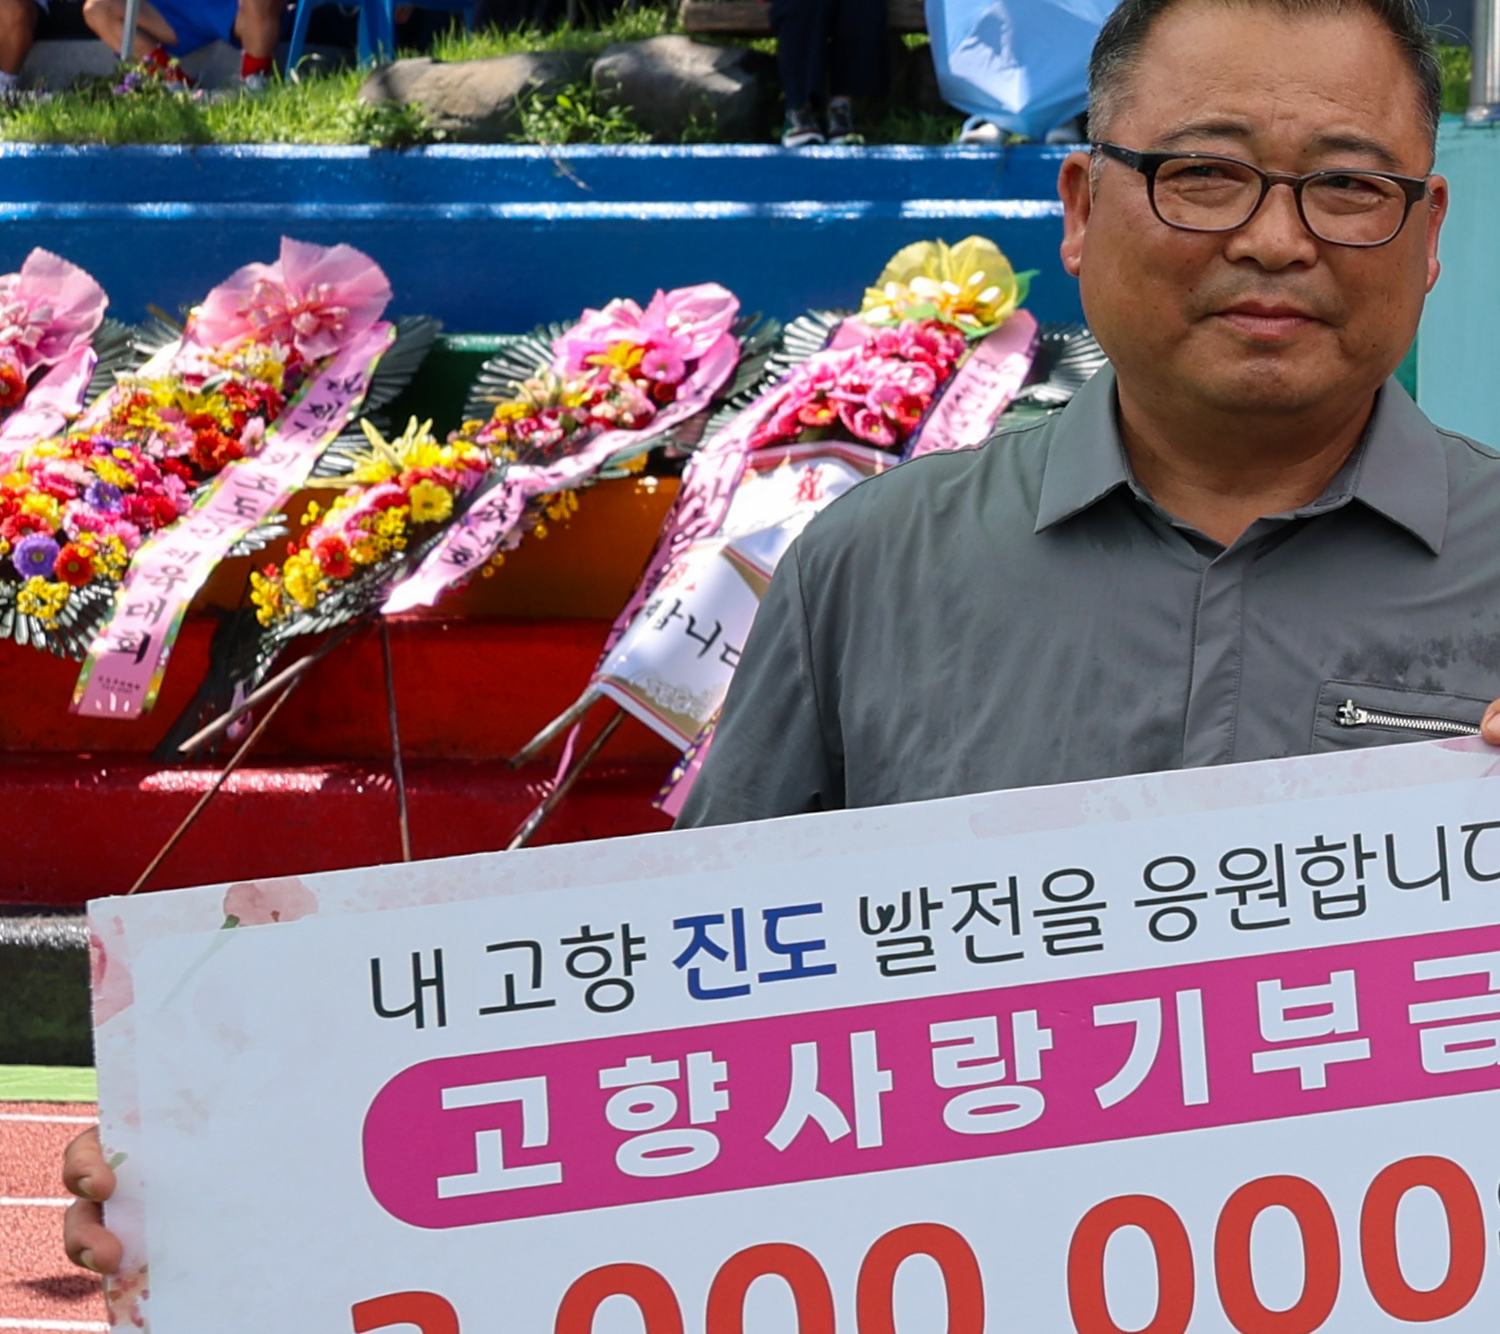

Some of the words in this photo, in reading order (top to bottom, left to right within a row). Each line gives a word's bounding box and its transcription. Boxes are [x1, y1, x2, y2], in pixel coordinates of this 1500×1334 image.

[371, 949, 446, 1029] 내
[479, 923, 646, 1015] 고향
[674, 904, 836, 999] 진도
[860, 876, 1110, 980] 발전을
